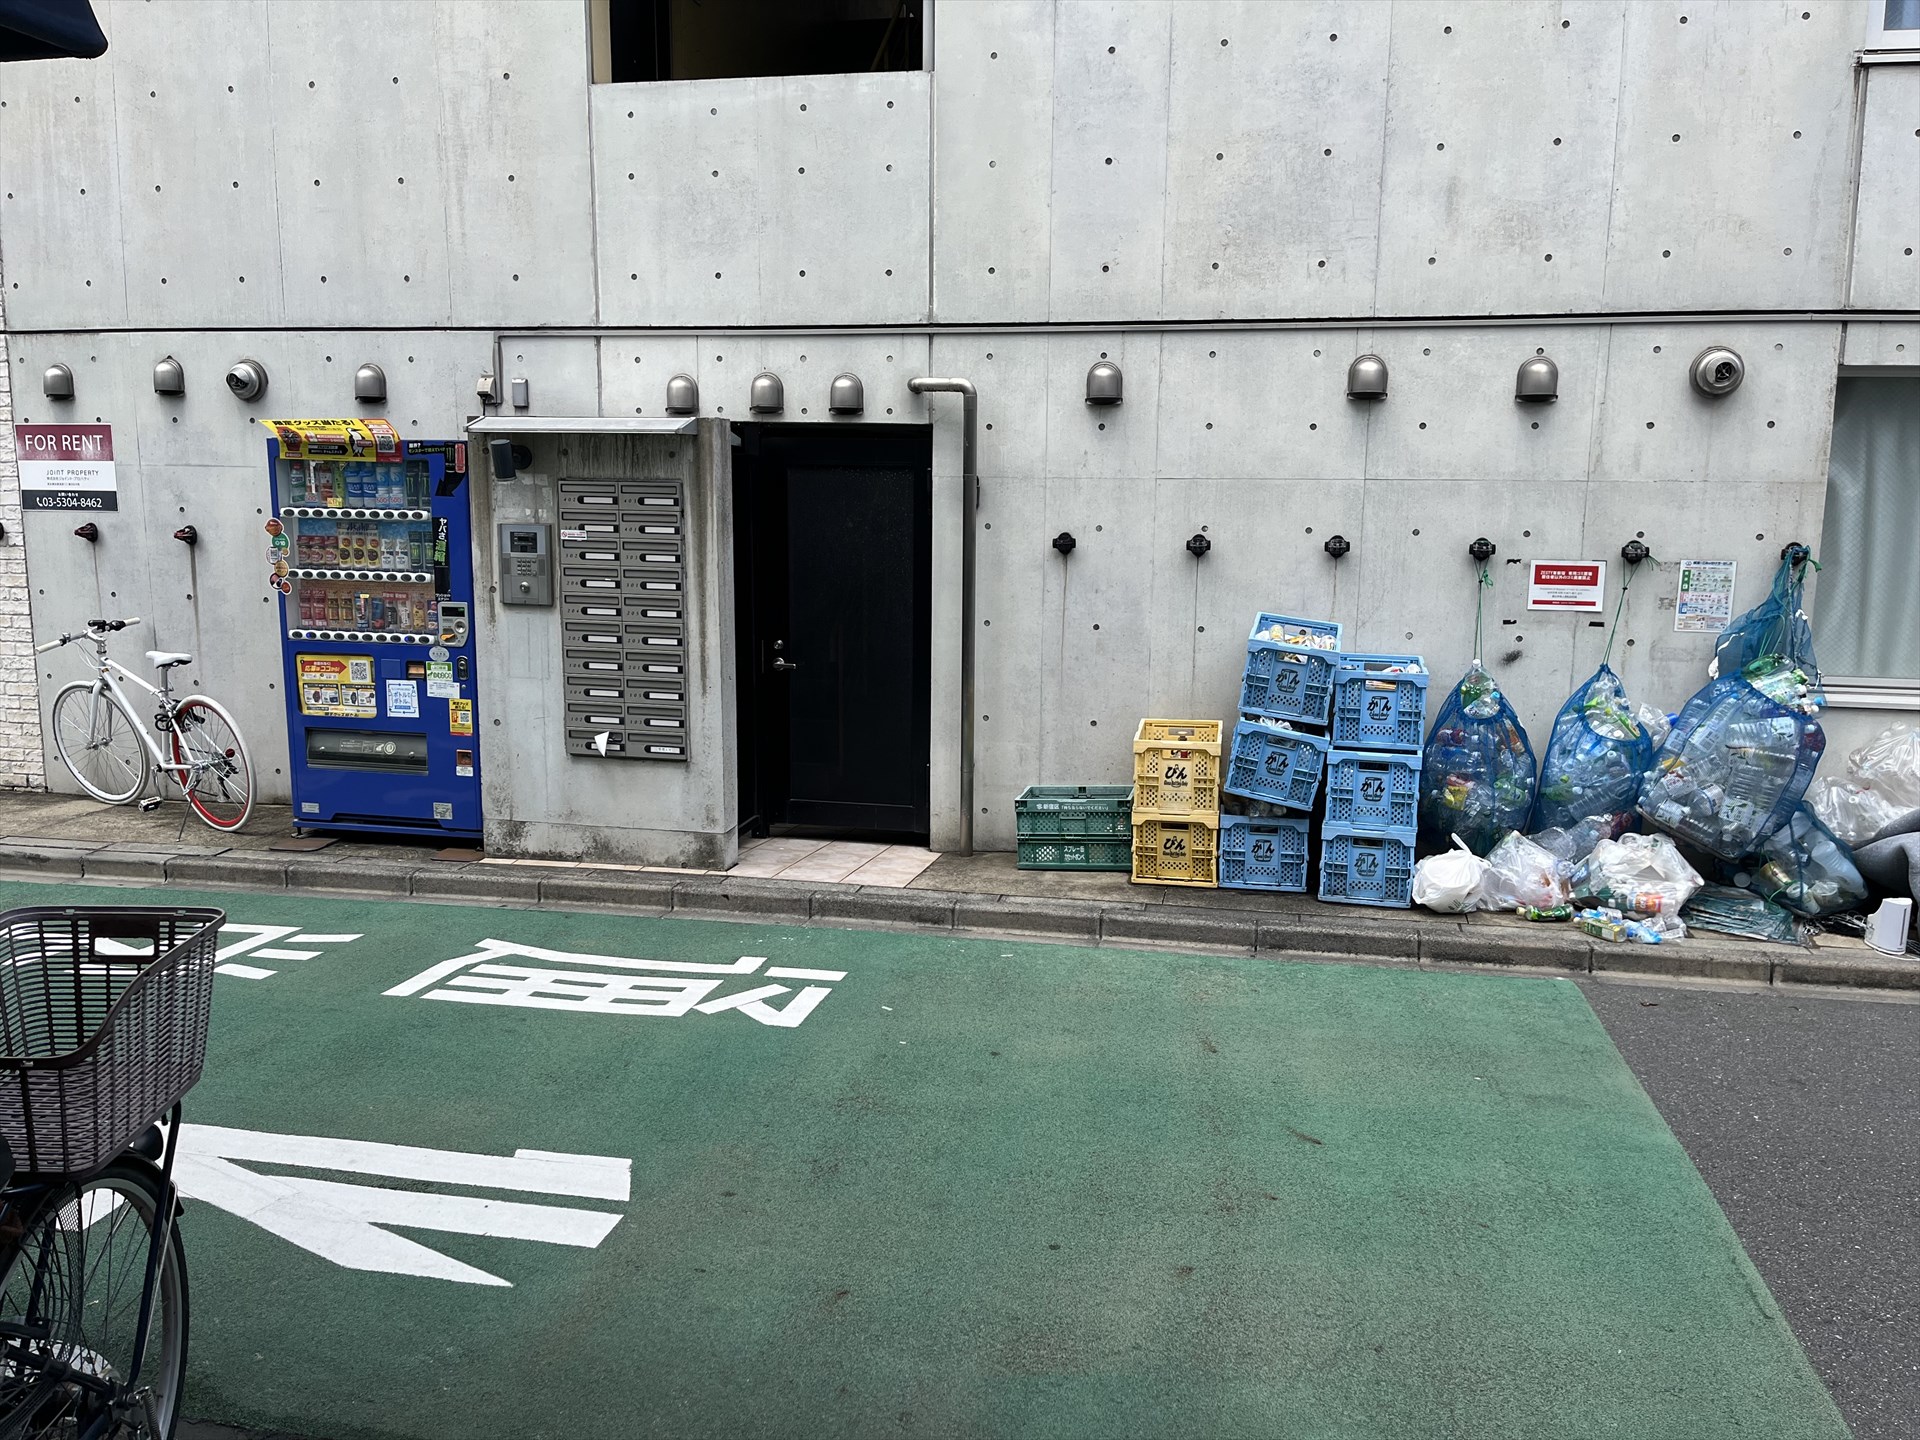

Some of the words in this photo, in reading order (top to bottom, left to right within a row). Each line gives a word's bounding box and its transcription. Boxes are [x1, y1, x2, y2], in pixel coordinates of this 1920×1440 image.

[24, 434, 57, 452] FOR
[62, 434, 104, 452] RENT
[42, 497, 102, 508] 03-5304-8462
[1275, 673, 1301, 685] かん
[1366, 698, 1392, 712] かん
[1264, 752, 1289, 769] かん
[1164, 766, 1187, 780] びん
[1360, 779, 1385, 793] かん
[1063, 845, 1085, 853] スプレー缶
[1163, 837, 1186, 851] びん
[1251, 842, 1275, 855] かん
[1354, 855, 1379, 868] かん
